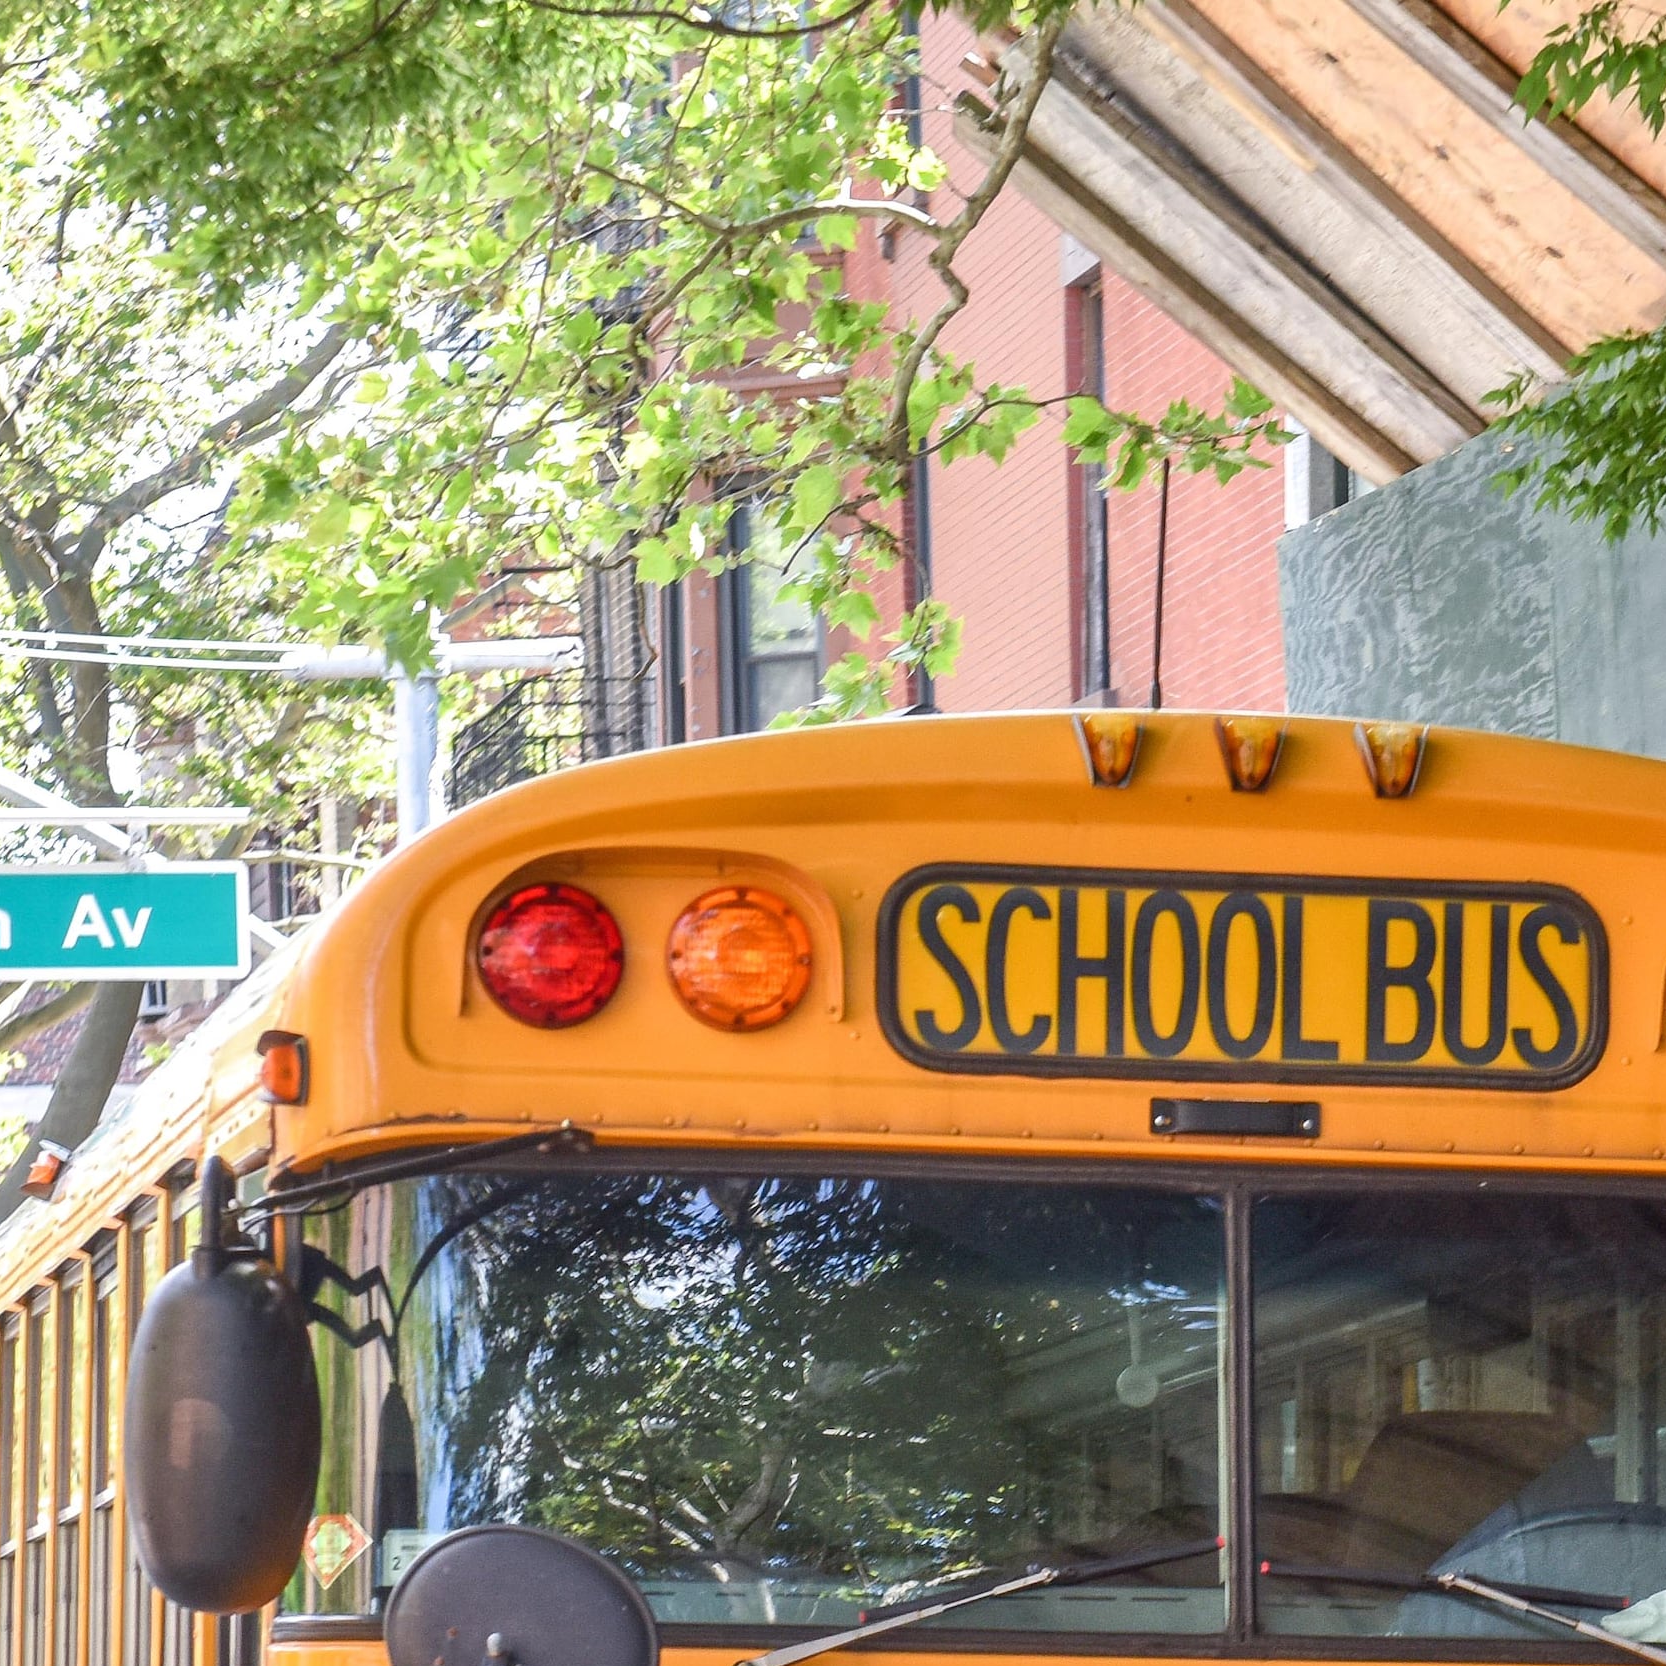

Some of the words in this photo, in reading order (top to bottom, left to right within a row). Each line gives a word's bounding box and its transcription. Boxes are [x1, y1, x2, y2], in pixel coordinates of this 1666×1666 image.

[62, 894, 153, 950] Av
[914, 885, 1340, 1062] SCHOOL
[1365, 898, 1582, 1069] BUS
